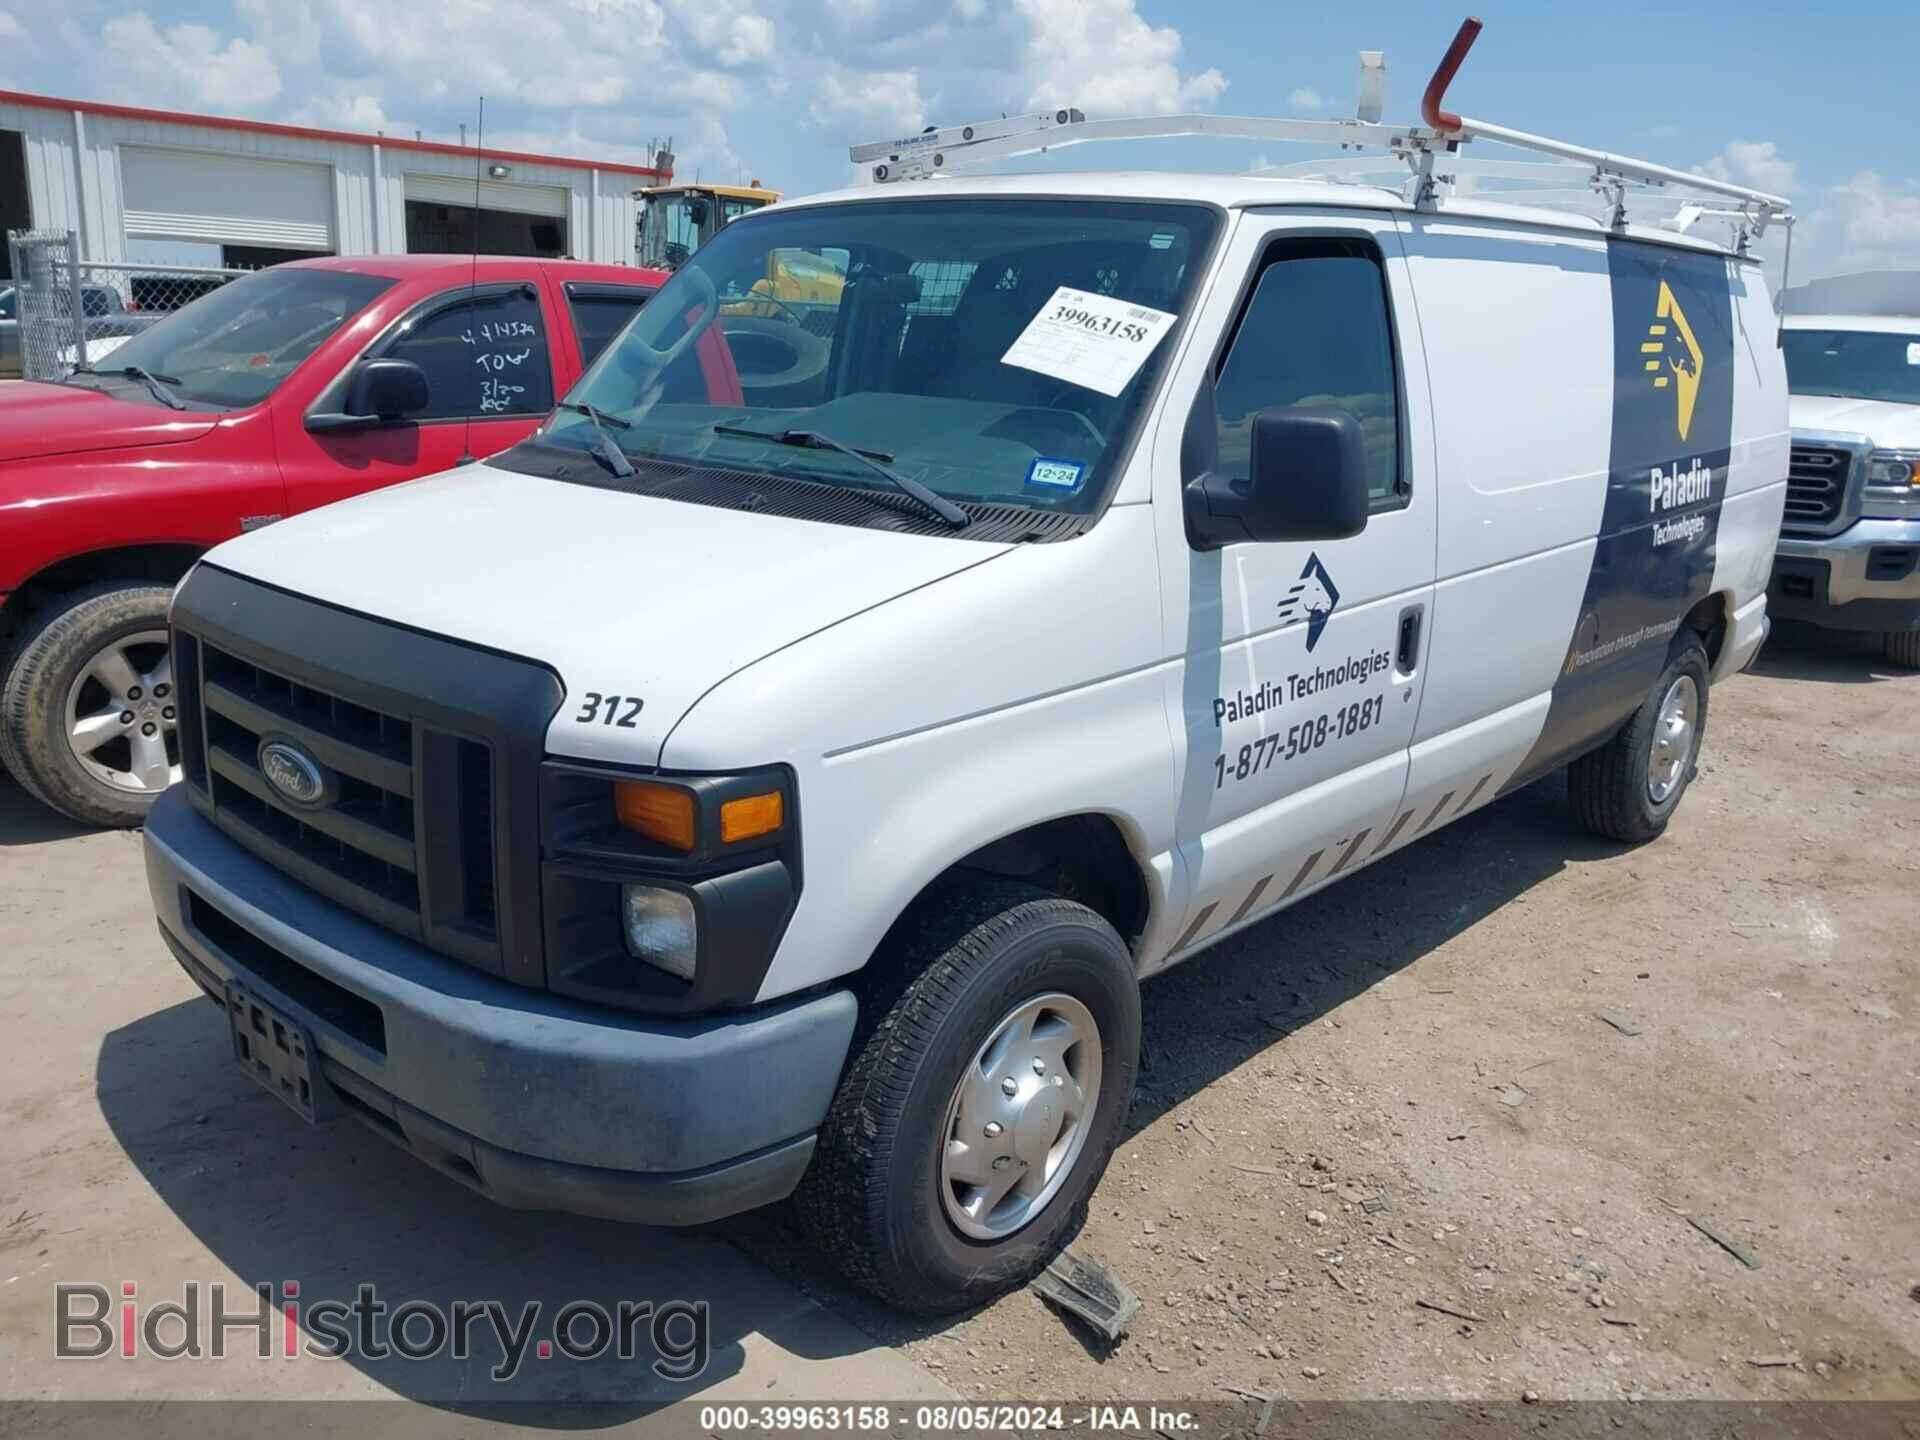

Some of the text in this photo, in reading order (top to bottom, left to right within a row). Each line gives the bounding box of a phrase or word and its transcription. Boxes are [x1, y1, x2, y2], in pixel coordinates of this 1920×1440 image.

[1049, 306, 1148, 343] 39963158
[1650, 458, 1711, 513] Paladin
[1652, 512, 1705, 547] Technologies
[1213, 648, 1391, 727] Paladin Technologies
[576, 692, 644, 728] 312
[1215, 694, 1384, 789] 1-877-508-1881
[271, 753, 301, 791] Ford
